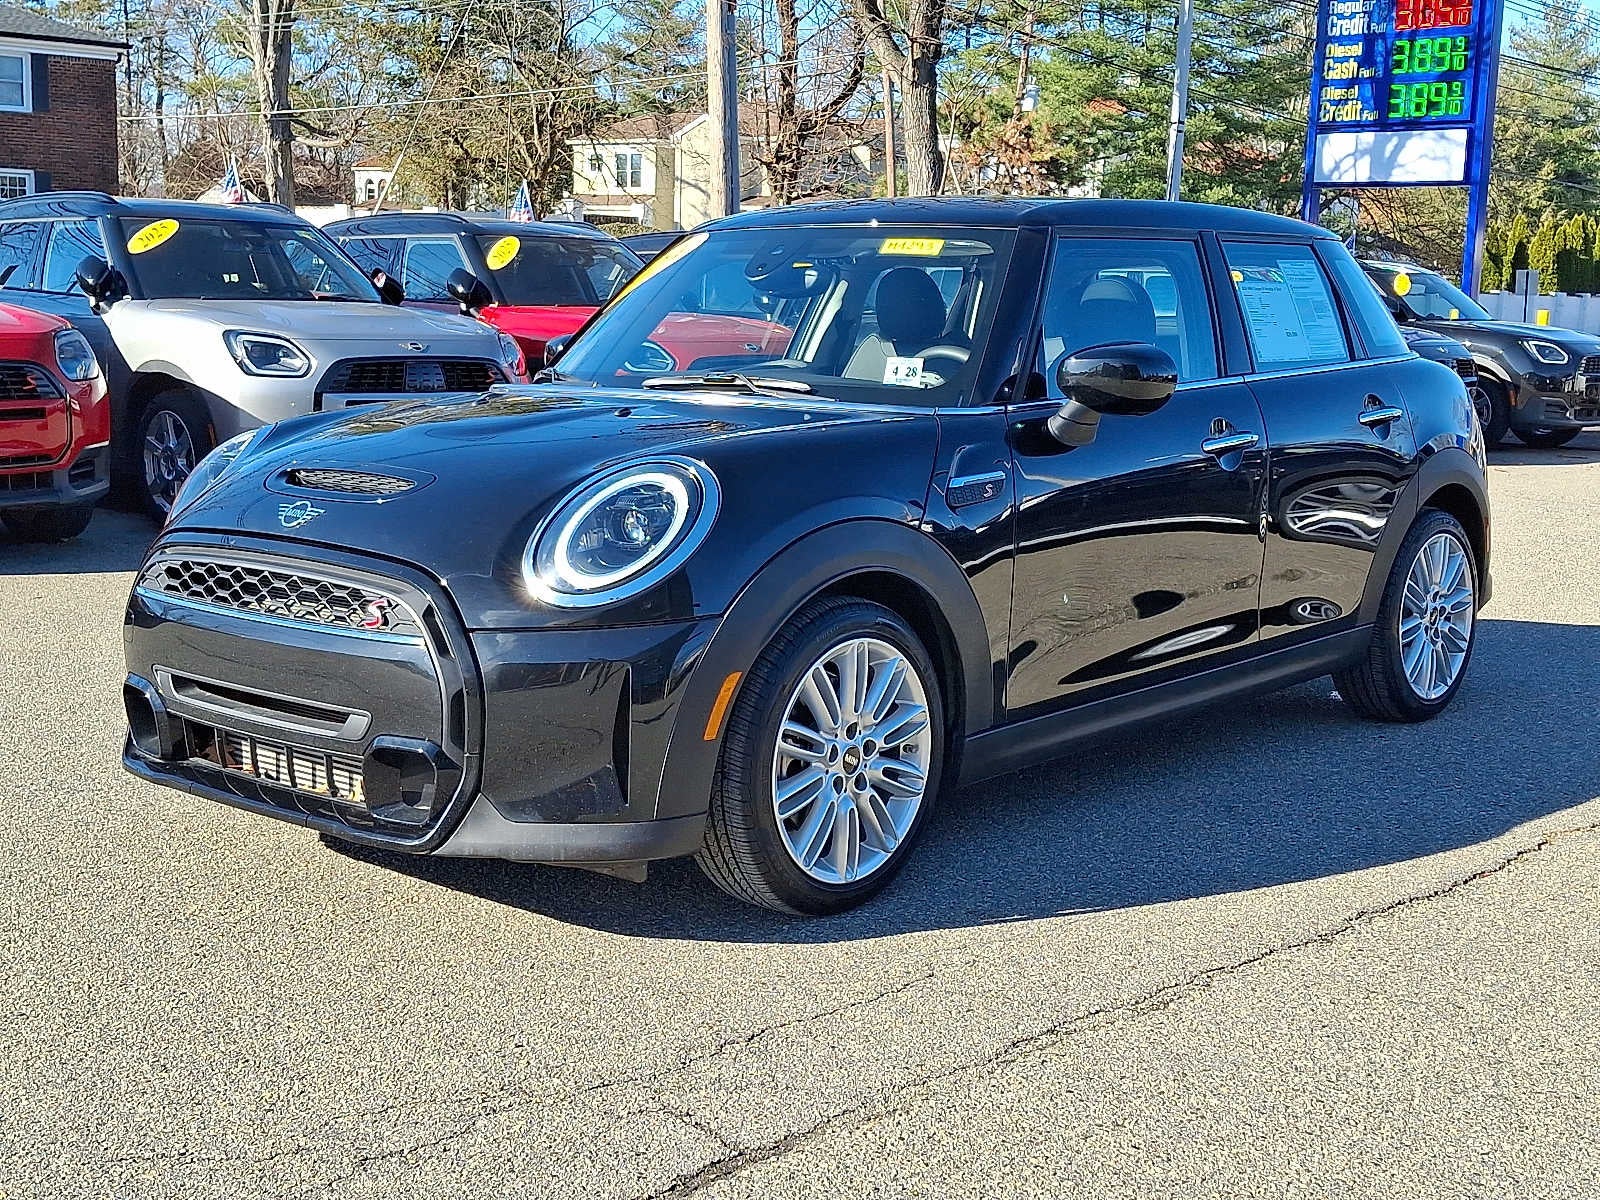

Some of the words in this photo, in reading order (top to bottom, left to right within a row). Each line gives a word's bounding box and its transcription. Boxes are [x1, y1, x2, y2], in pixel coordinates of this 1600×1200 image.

[1329, 0, 1375, 16] Regular
[1327, 13, 1369, 36] Credit
[1325, 42, 1363, 57] Diesel
[1324, 58, 1358, 79] Cash
[1321, 85, 1359, 101] Diesel
[1320, 100, 1362, 121] Credit
[136, 222, 169, 249] 2025
[892, 366, 899, 376] 4
[905, 366, 918, 377] 28
